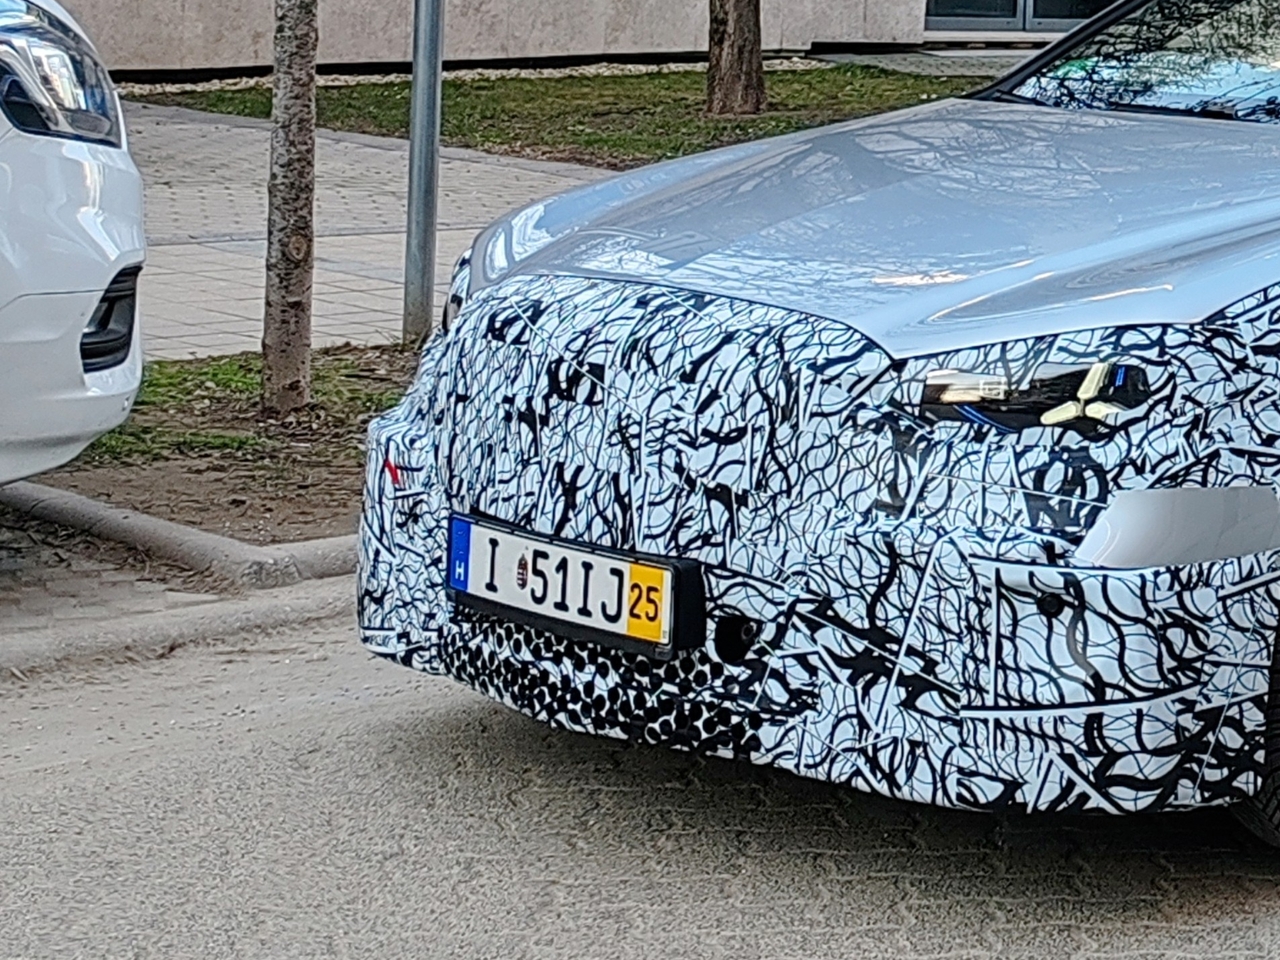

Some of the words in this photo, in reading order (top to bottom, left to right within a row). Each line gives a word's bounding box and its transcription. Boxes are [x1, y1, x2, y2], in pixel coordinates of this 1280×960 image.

[455, 560, 466, 581] H
[485, 537, 500, 593] I
[629, 582, 660, 622] 25
